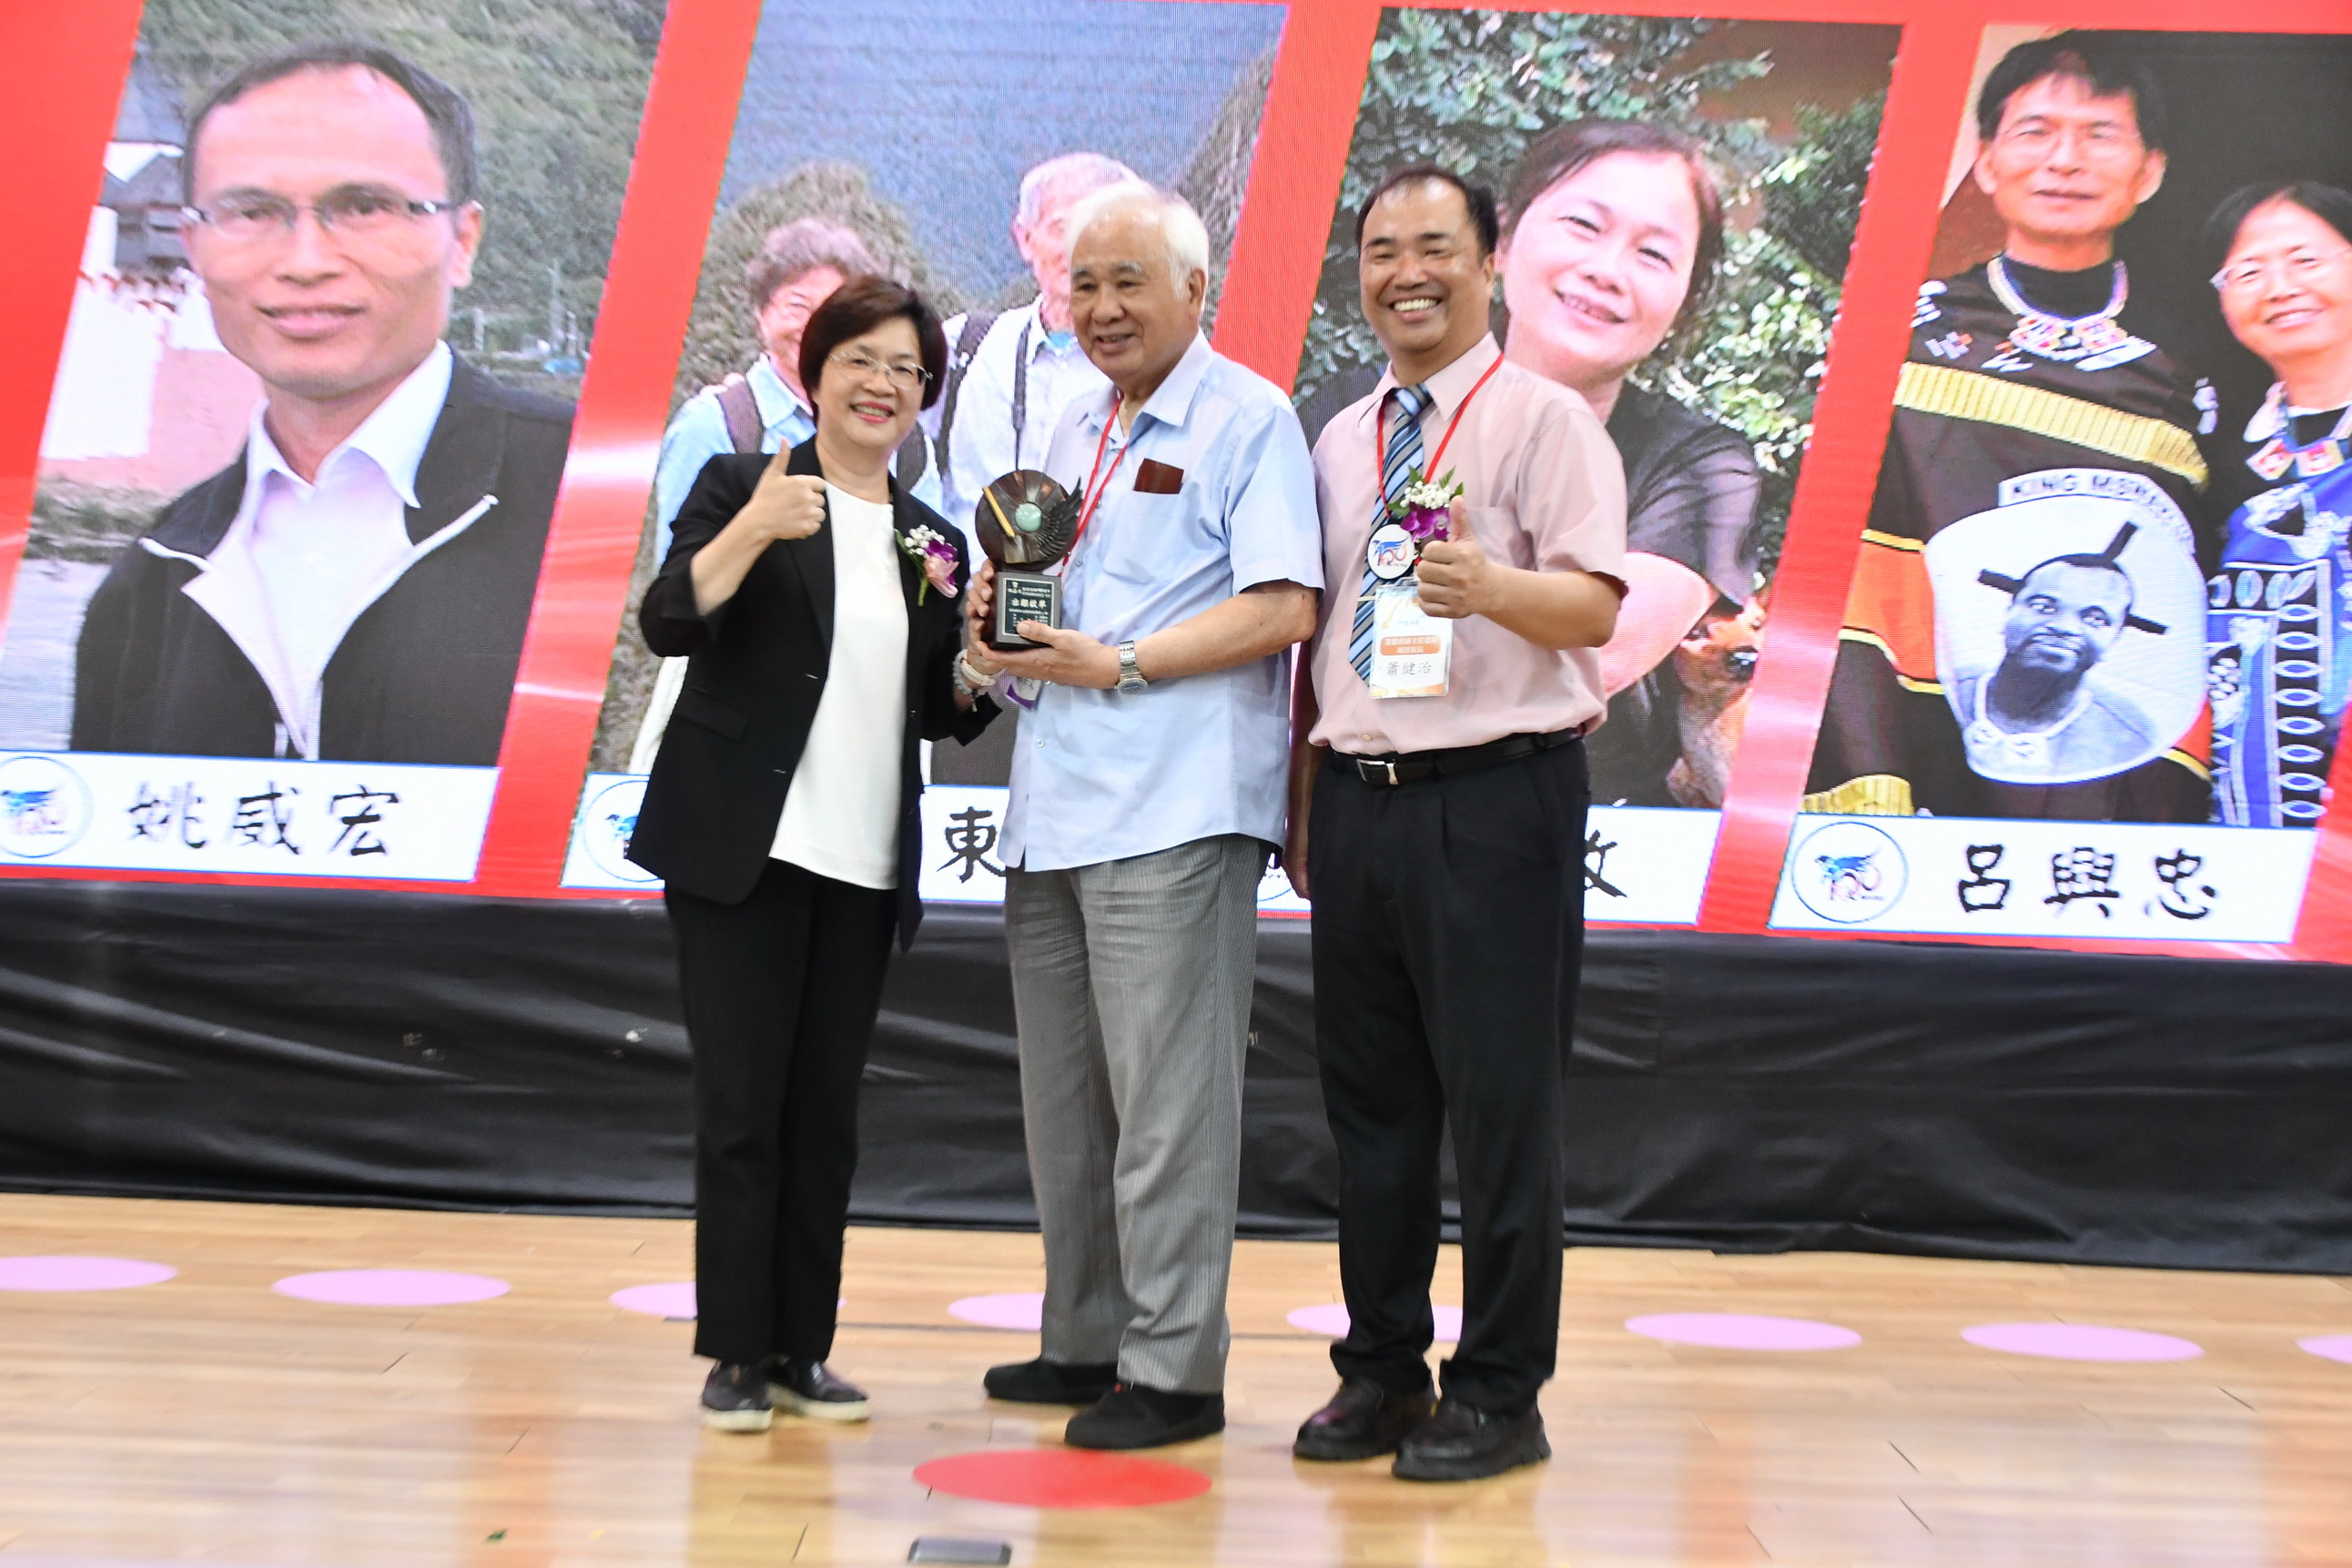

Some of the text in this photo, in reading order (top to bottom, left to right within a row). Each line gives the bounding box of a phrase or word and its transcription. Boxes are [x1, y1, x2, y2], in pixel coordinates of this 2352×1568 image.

[1387, 662, 1432, 675] 蕭健治
[127, 781, 401, 857] 姚威宏
[936, 806, 1008, 884] 東
[1957, 844, 2219, 921] 呂興忠
